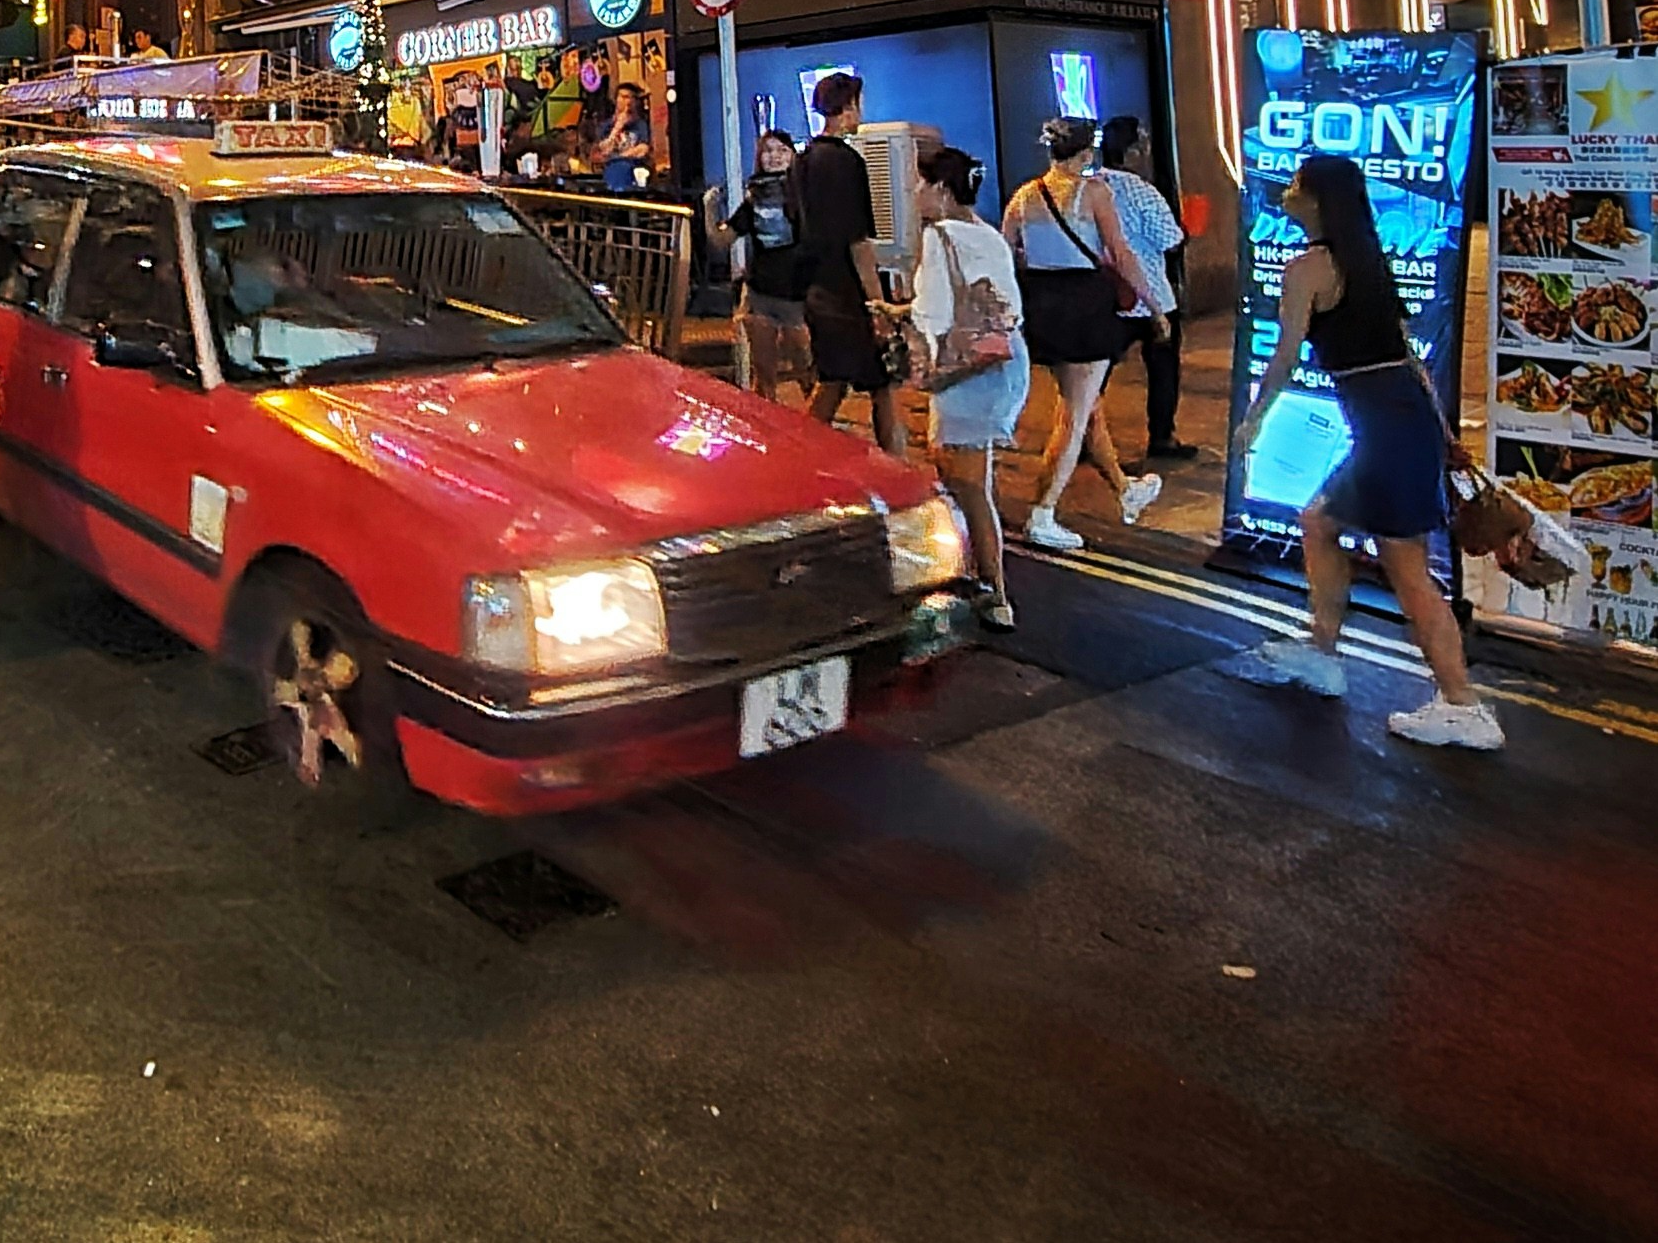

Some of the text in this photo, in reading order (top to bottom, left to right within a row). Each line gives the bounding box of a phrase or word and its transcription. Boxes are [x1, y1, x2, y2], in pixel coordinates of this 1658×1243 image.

[398, 6, 559, 67] CORNER BAR
[234, 125, 327, 148] TAXI
[1259, 101, 1449, 158] GON!
[1571, 135, 1618, 145] LUCKY
[1392, 259, 1437, 278] BAR
[1619, 542, 1658, 557] COCKT
